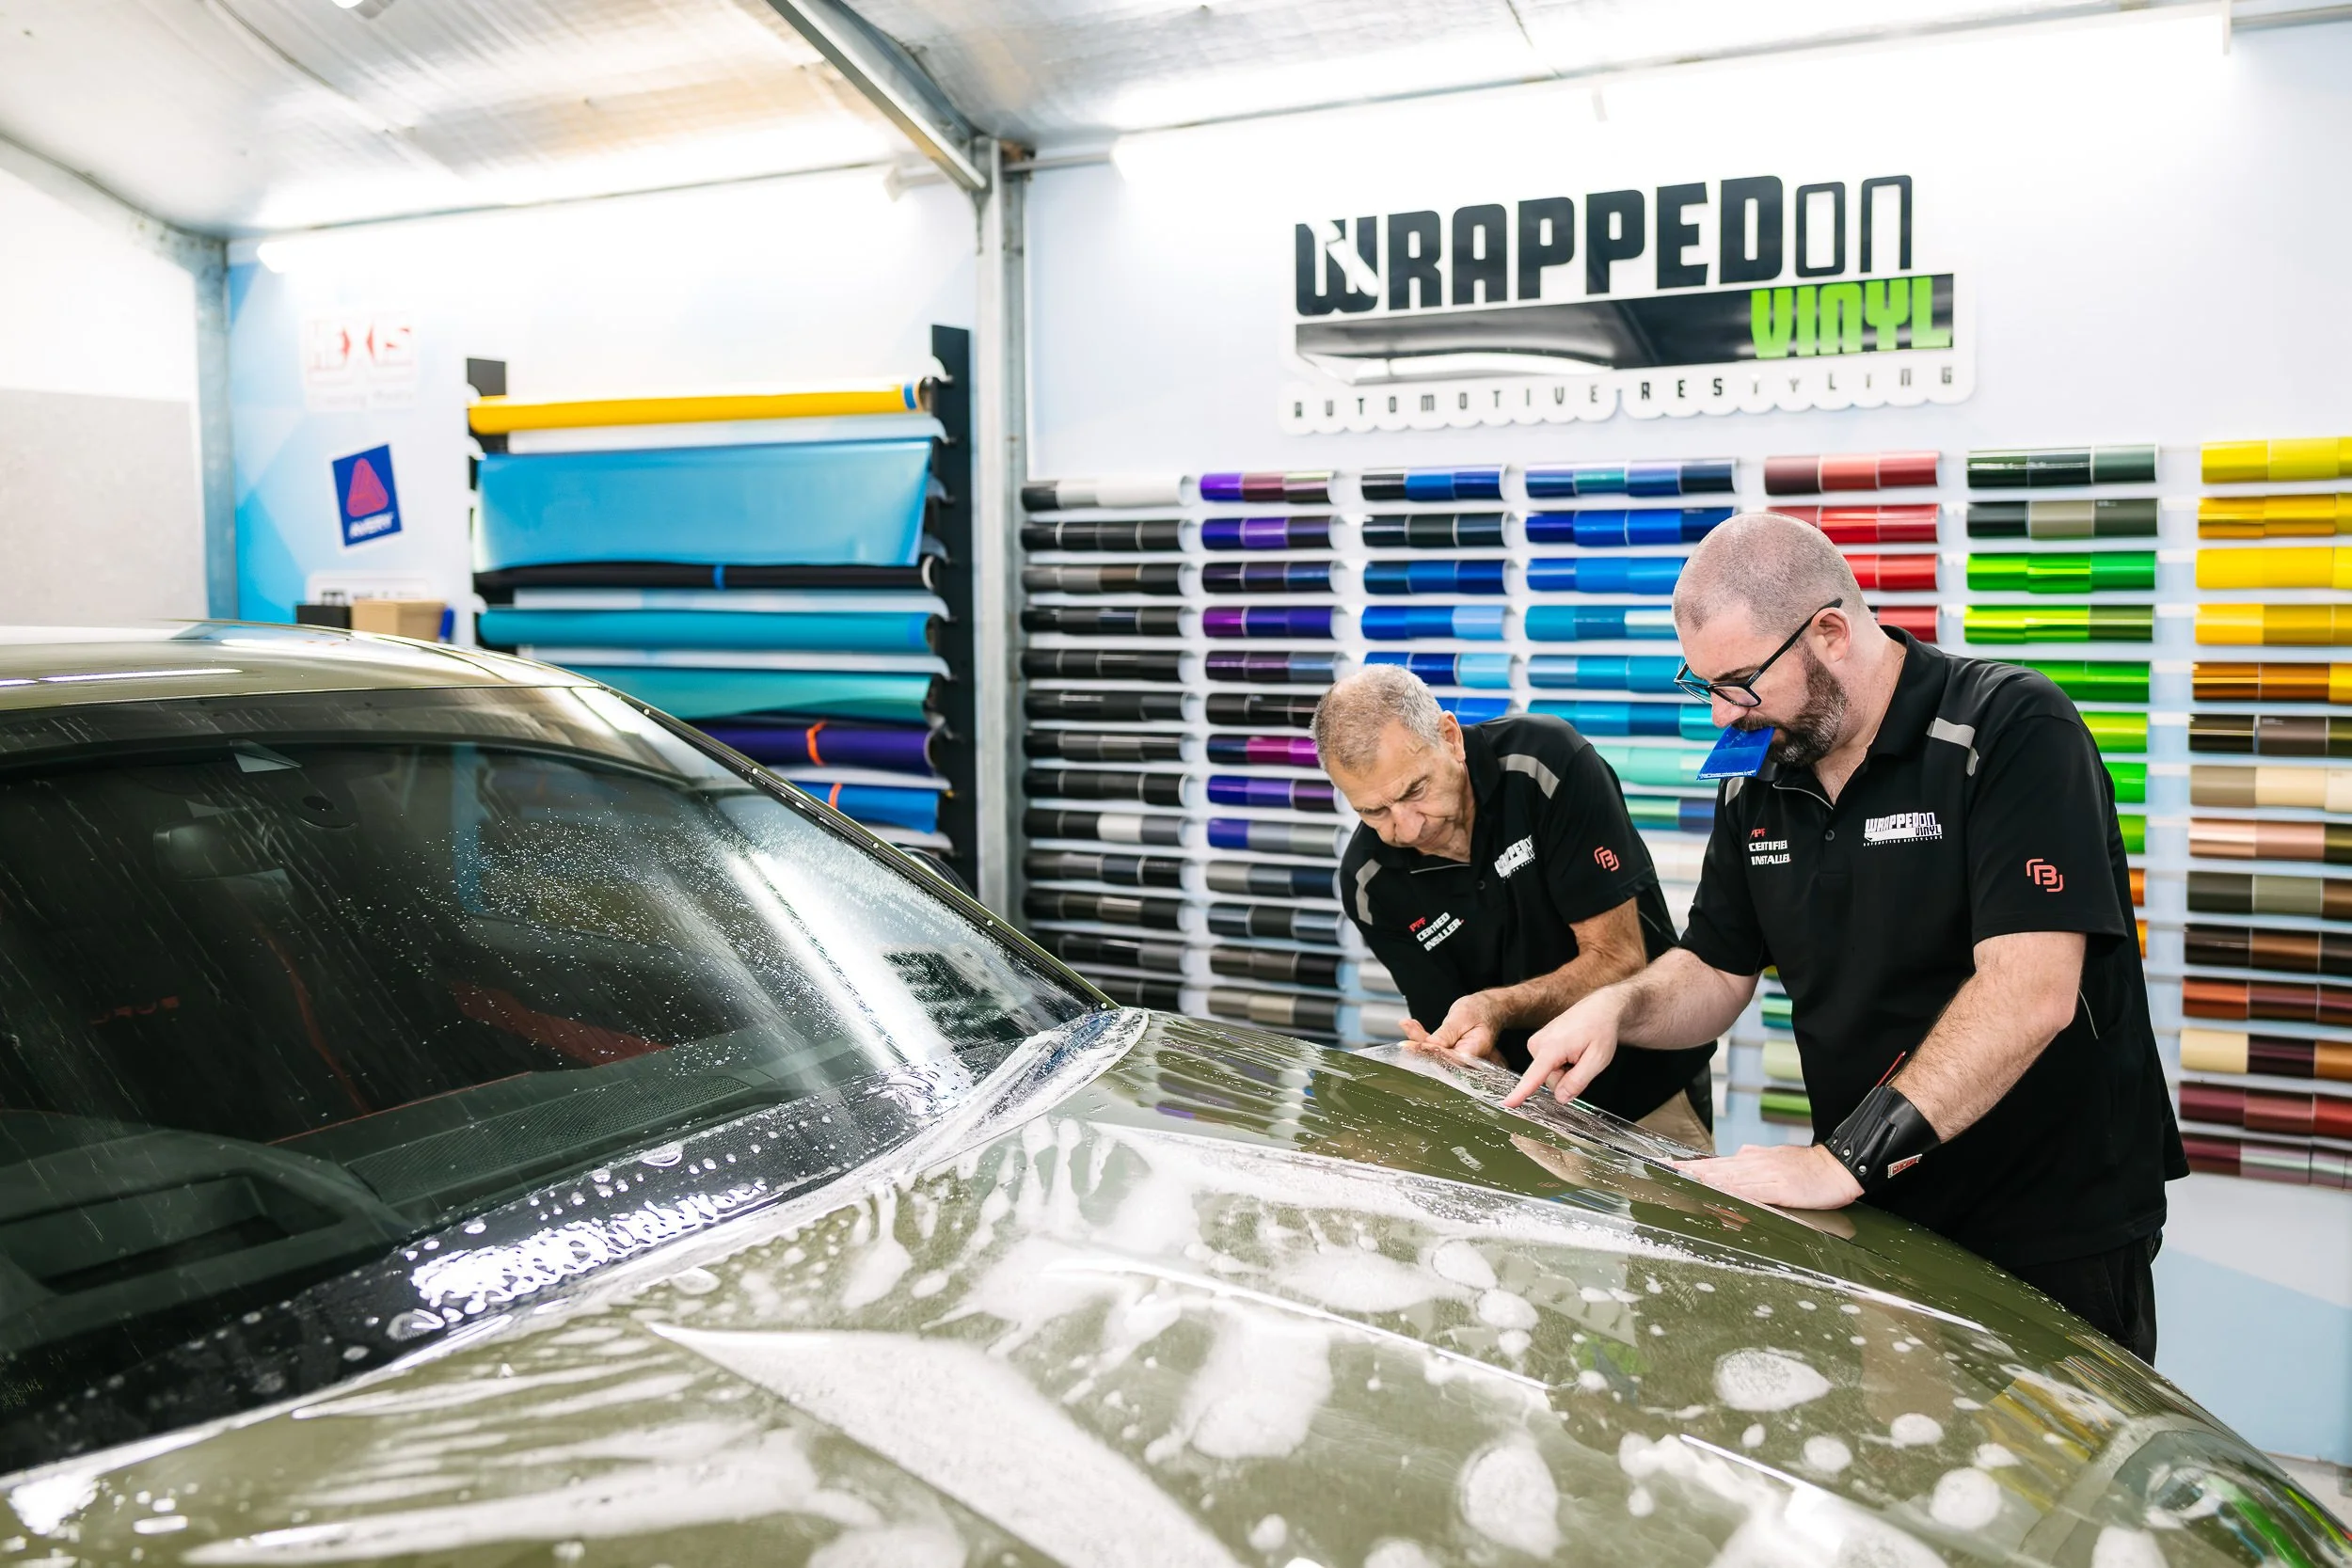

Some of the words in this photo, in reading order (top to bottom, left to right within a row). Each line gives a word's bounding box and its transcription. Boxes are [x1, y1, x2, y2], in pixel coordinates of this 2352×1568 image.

[1751, 276, 1951, 359] VINYL
[1294, 385, 1599, 419] AUTOMOTIVE
[1915, 826, 1941, 836] VINYL
